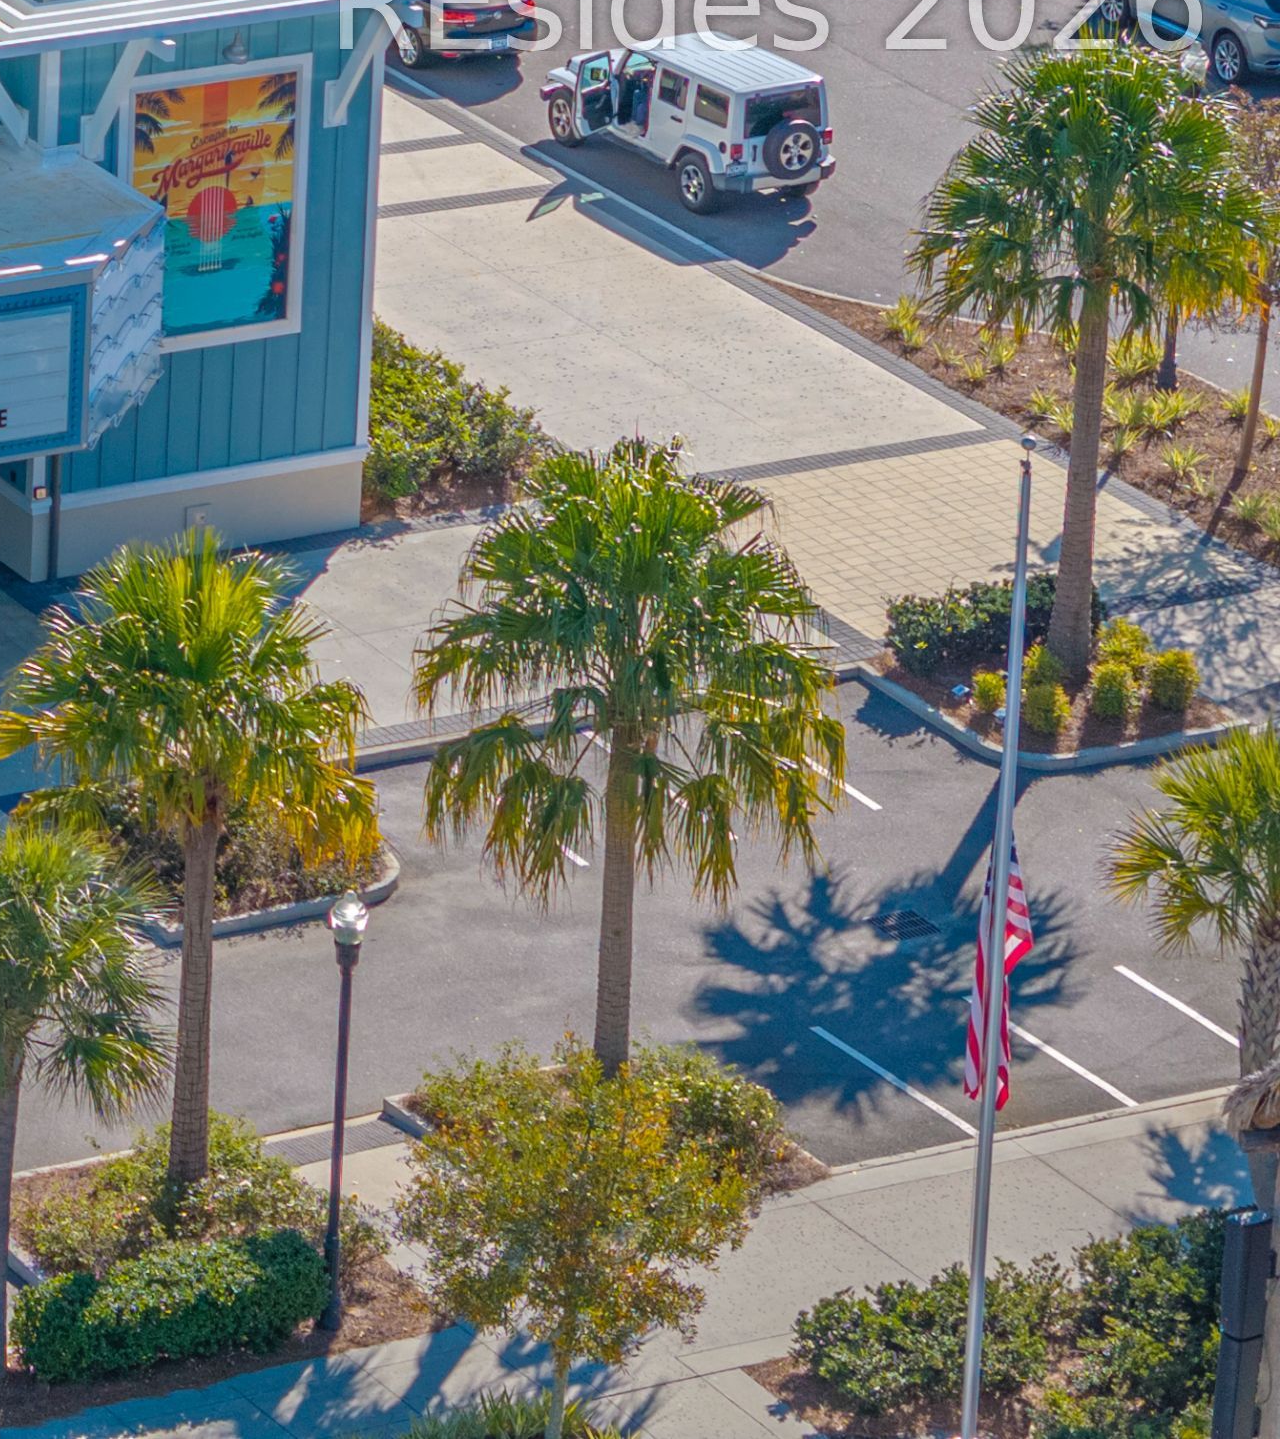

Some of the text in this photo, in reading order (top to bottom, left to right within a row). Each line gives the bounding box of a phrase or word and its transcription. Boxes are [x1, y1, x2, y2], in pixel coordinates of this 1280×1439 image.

[190, 124, 239, 149] Escape to
[150, 128, 272, 201] Margaritaville
